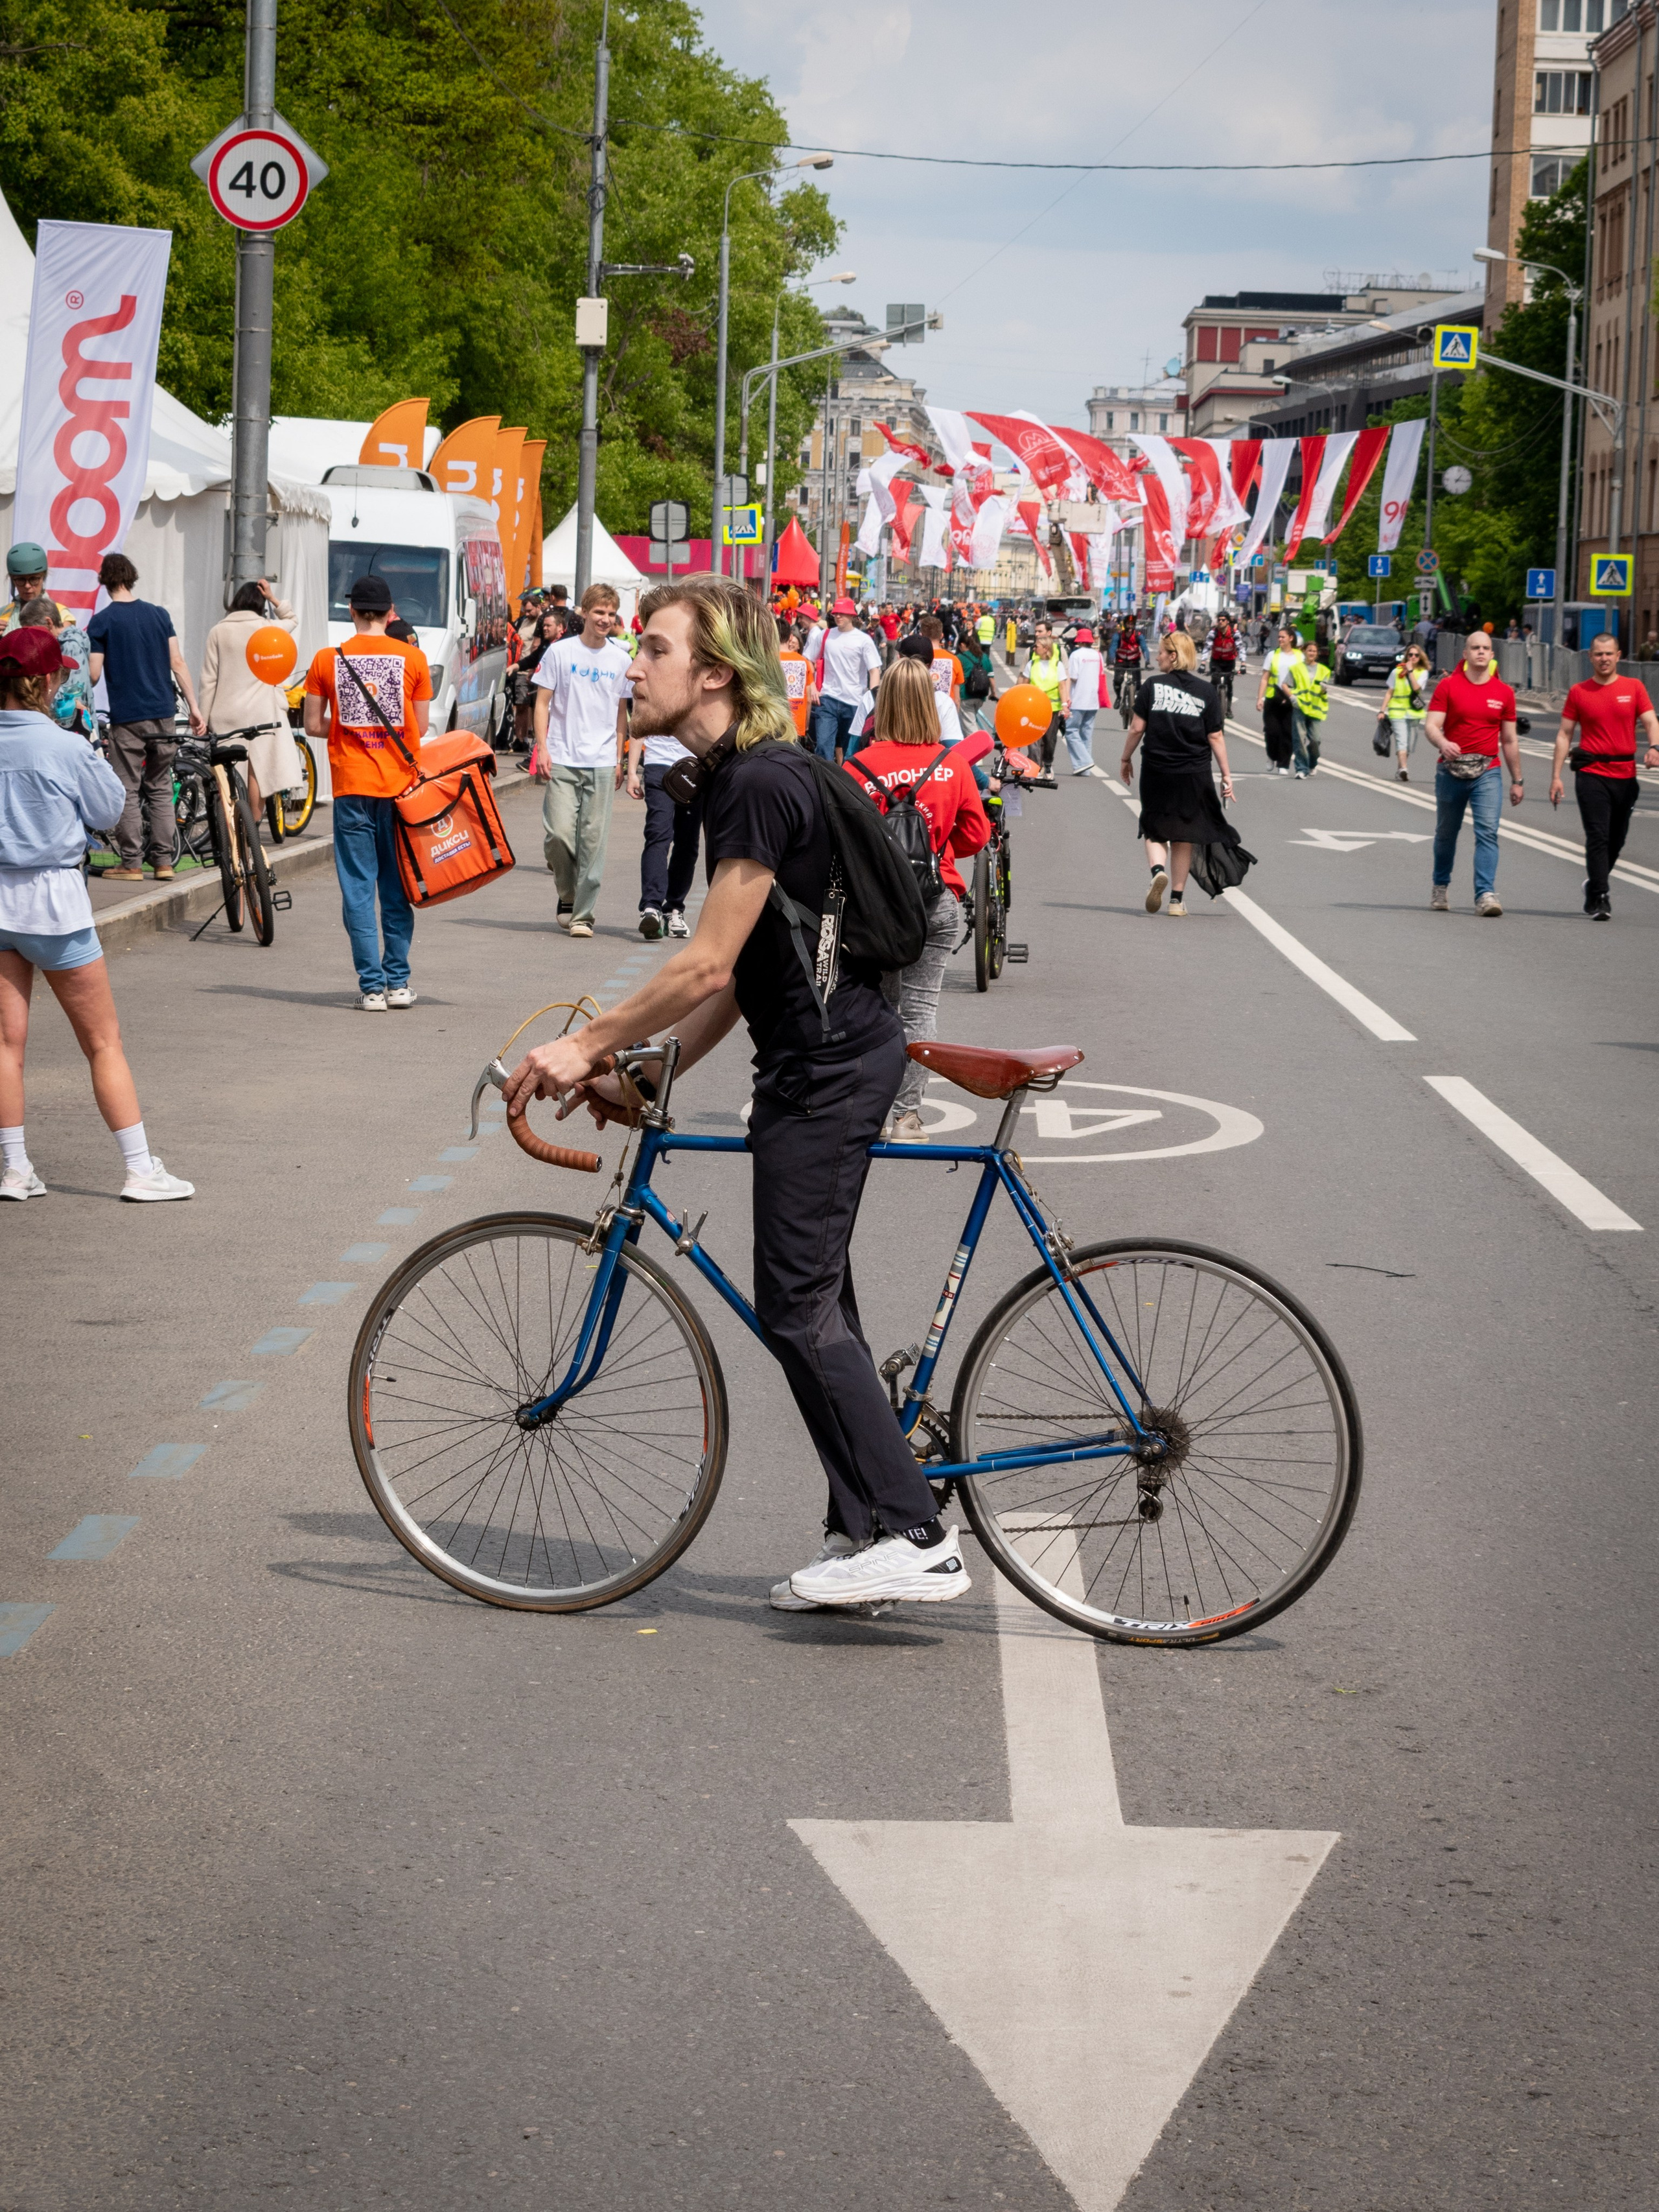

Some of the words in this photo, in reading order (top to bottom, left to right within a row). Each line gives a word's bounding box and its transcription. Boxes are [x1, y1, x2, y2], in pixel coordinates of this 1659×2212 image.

[229, 161, 286, 200] 40
[1154, 683, 1195, 705] BACK
[434, 848, 458, 863] ДОСТАВКА
